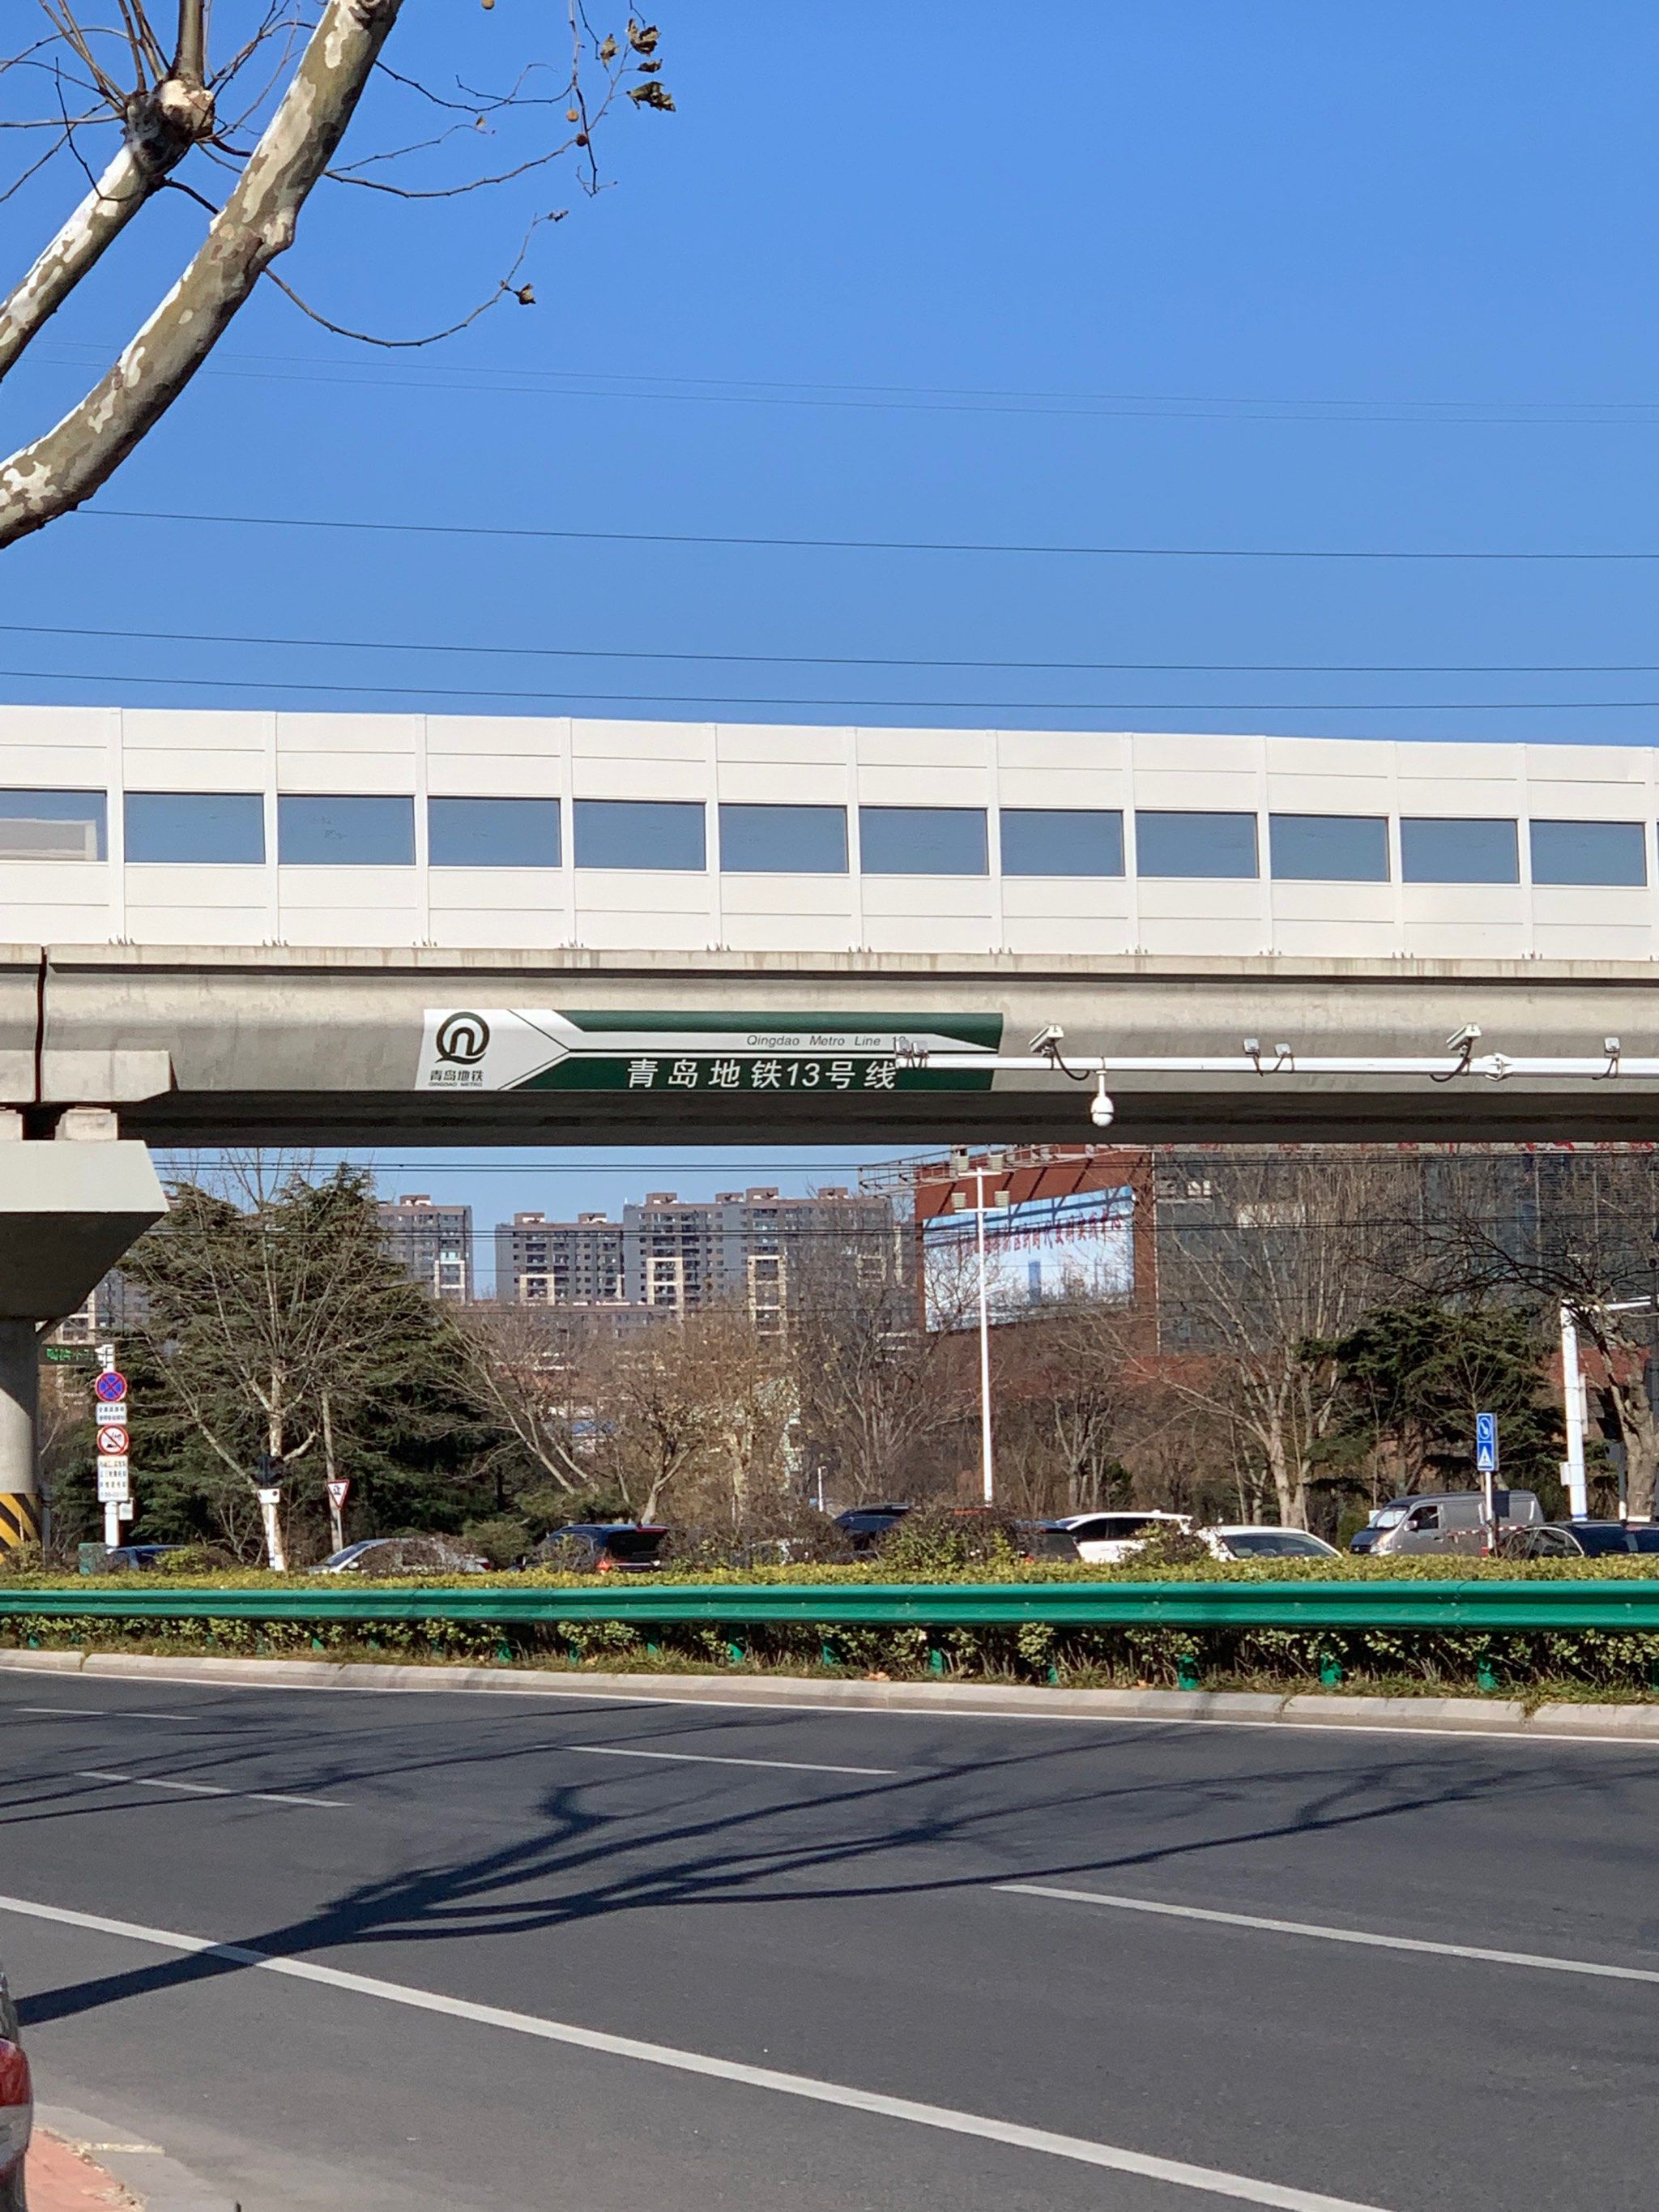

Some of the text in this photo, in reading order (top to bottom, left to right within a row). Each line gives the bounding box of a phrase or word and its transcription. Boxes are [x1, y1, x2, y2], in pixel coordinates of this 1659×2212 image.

[746, 1034, 800, 1048] Qingdao
[809, 1036, 846, 1046] Metro
[854, 1036, 881, 1046] Line
[430, 1070, 484, 1082] 青岛地铁
[627, 1058, 896, 1089] 青岛地铁13号线
